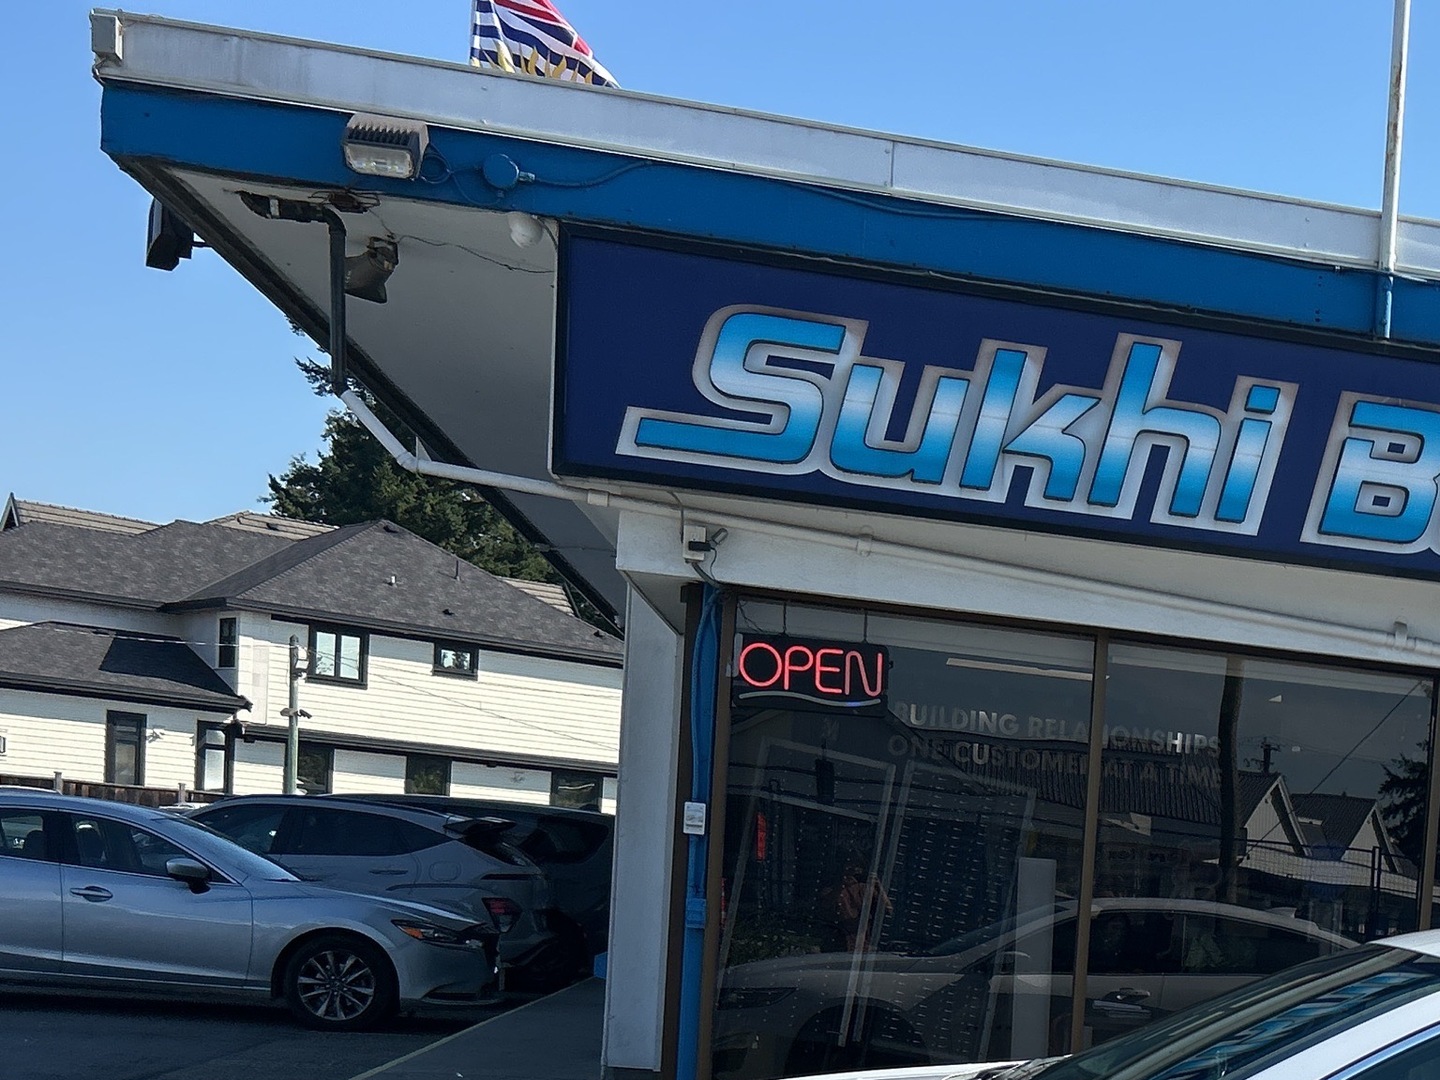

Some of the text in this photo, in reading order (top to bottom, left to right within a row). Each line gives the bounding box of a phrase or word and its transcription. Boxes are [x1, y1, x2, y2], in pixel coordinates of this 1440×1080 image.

[615, 304, 1298, 536] Sukhi
[739, 642, 884, 696] OPEN
[894, 701, 1020, 736] BUILDING
[888, 735, 944, 761] ONE
